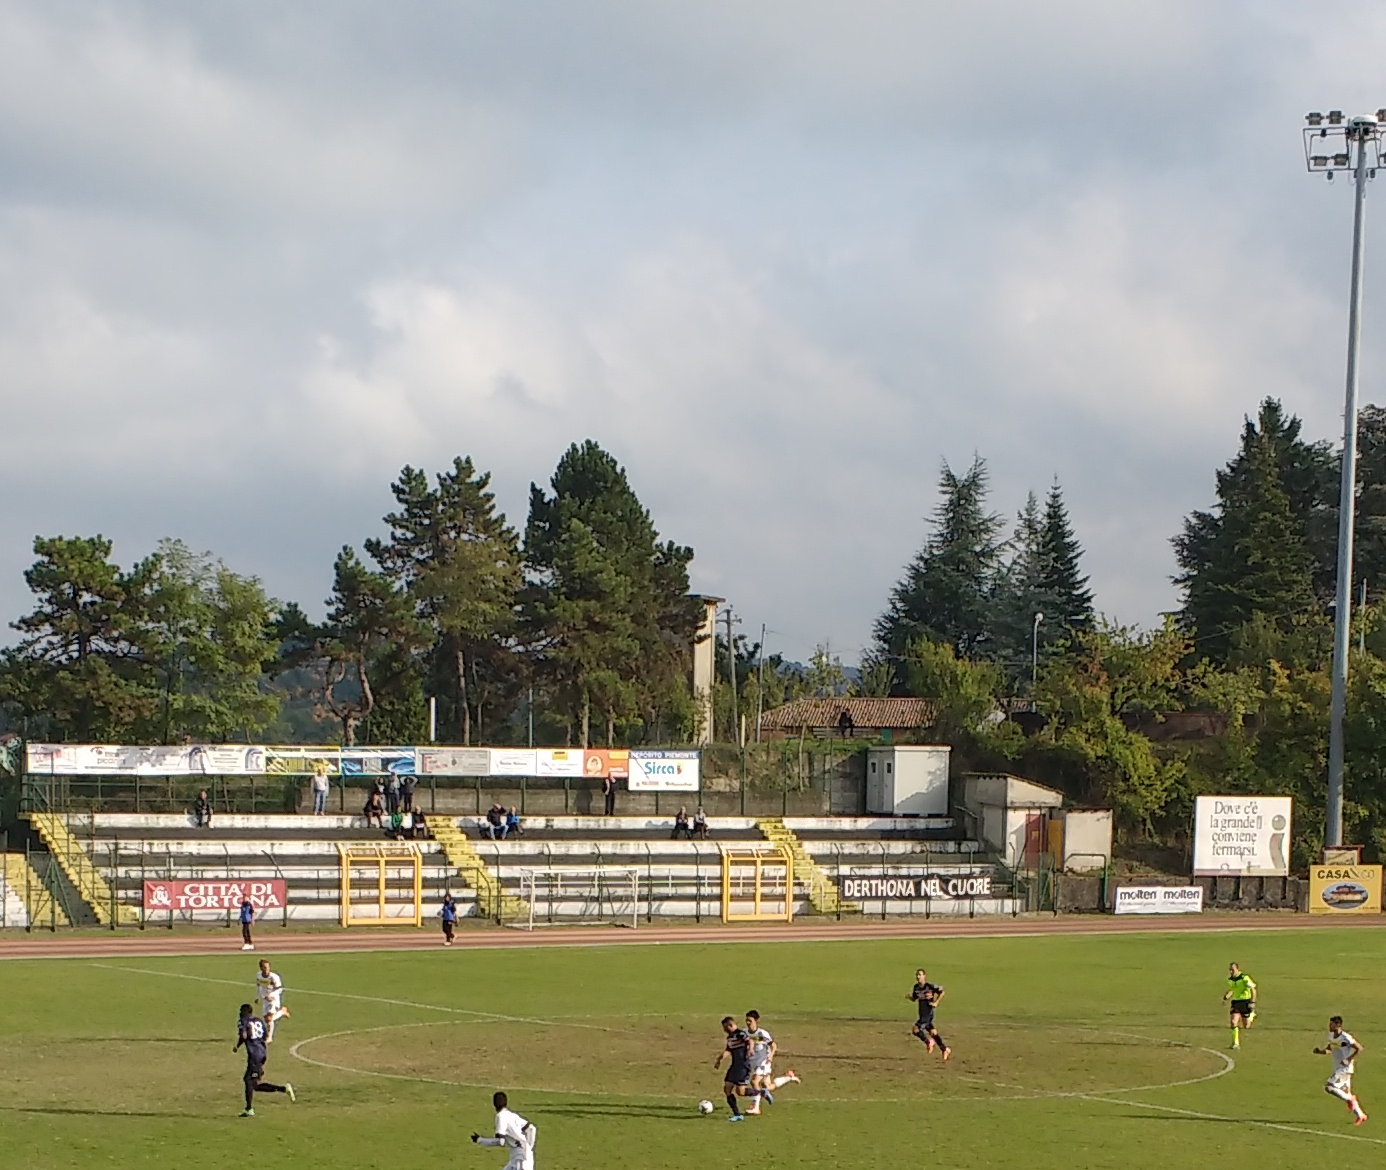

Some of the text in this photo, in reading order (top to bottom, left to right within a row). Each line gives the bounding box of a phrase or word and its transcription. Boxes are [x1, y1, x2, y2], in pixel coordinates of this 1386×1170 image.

[645, 761, 675, 775] Sirca
[1214, 801, 1259, 815] Dove c'è
[1210, 814, 1255, 831] la grande
[1212, 832, 1257, 842] conviene
[1317, 869, 1351, 879] CASA
[251, 883, 273, 895] DI
[844, 877, 991, 897] DERTHONA NEL CUORE
[1120, 890, 1200, 900] molten molten
[249, 1021, 264, 1039] 18
